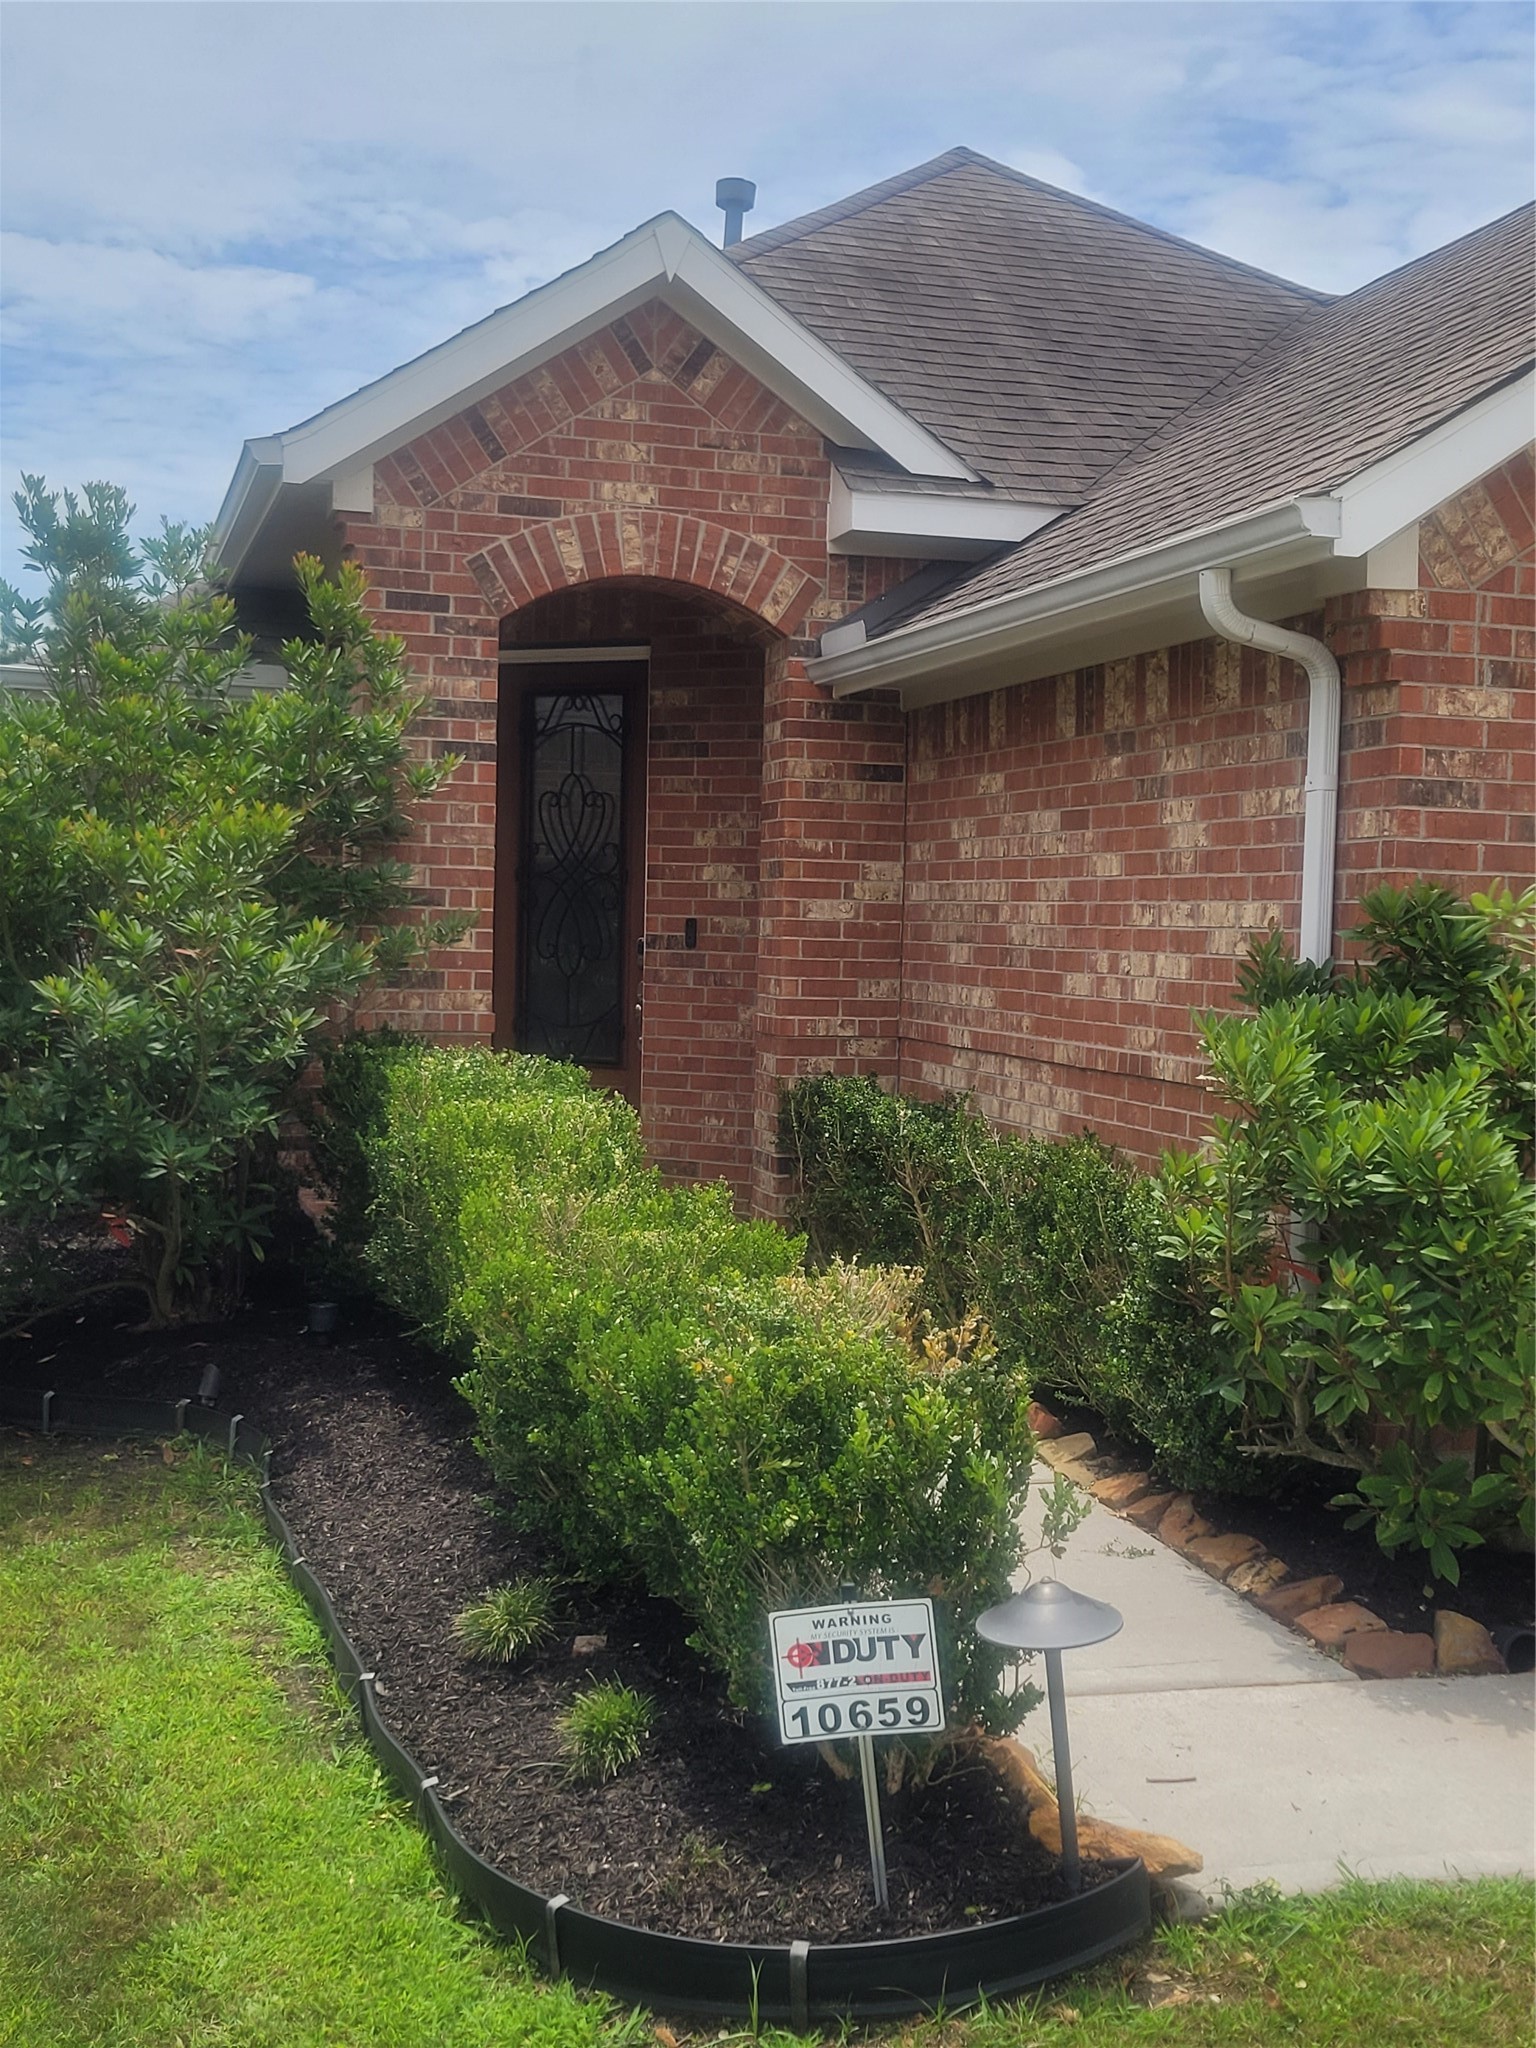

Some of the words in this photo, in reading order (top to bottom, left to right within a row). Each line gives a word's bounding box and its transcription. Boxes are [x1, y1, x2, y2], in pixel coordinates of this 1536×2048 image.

[812, 1613, 892, 1630] WARNING
[810, 1632, 822, 1640] MY
[823, 1629, 858, 1639] SECURITY
[859, 1627, 888, 1636] SYSTEM
[887, 1626, 896, 1634] IS
[791, 1696, 930, 1737] 10659
